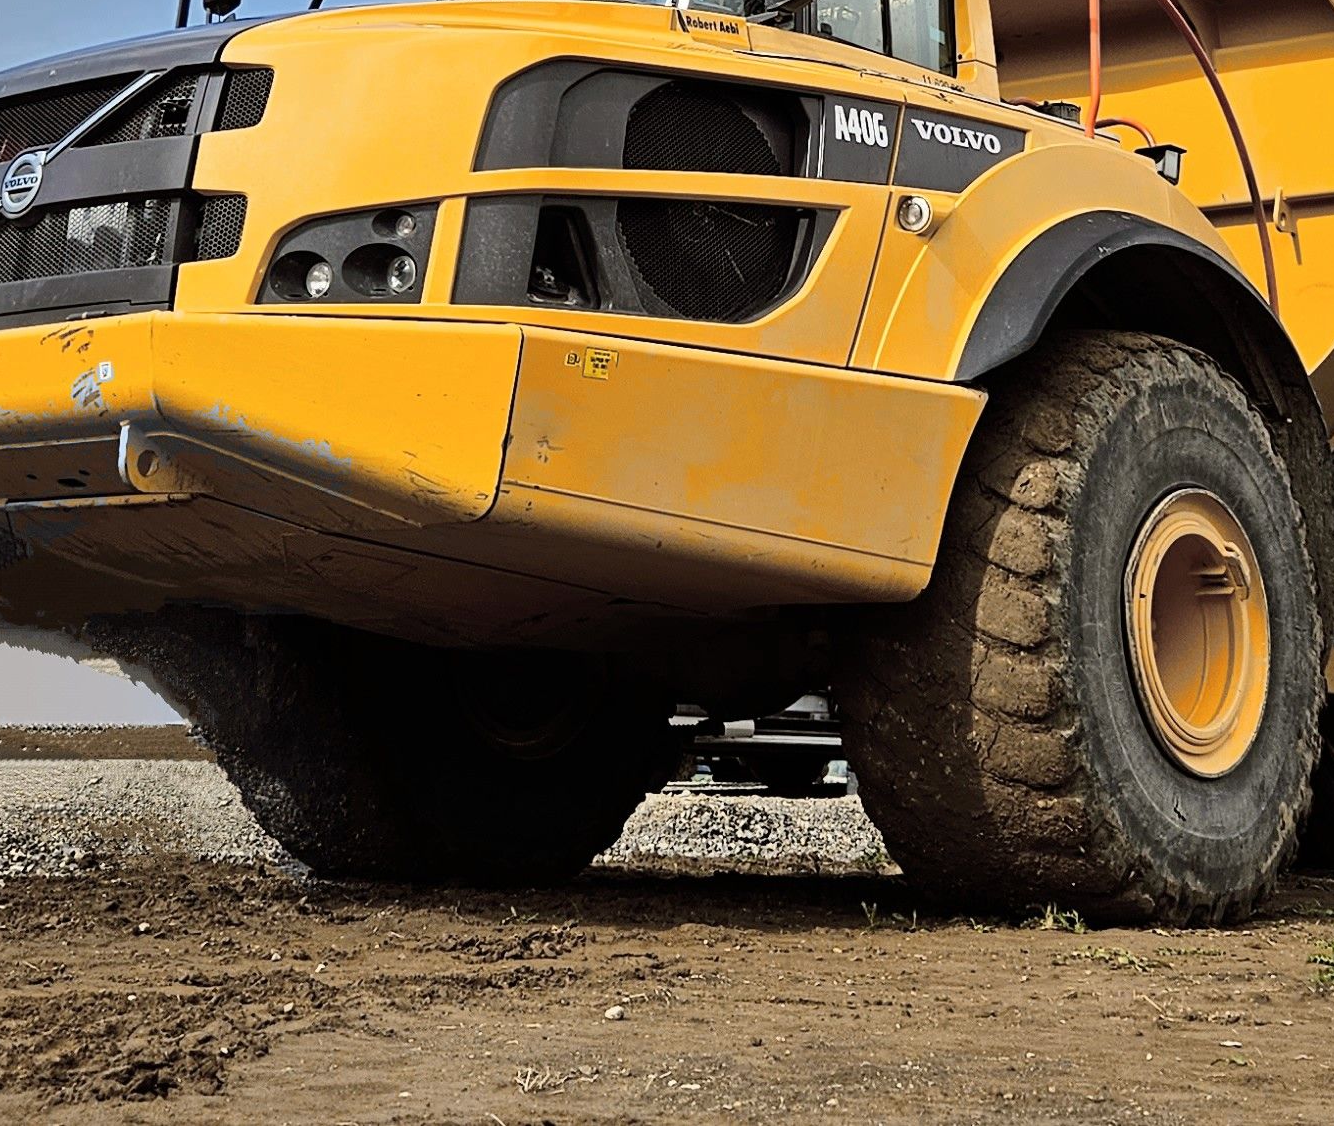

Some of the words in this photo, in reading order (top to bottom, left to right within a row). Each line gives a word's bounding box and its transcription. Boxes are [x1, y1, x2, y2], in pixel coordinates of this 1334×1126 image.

[685, 16, 717, 31] Robert
[720, 21, 740, 35] Aebi
[835, 105, 889, 147] A40G
[911, 118, 1001, 154] VOLVO
[4, 176, 38, 188] VOLVO
